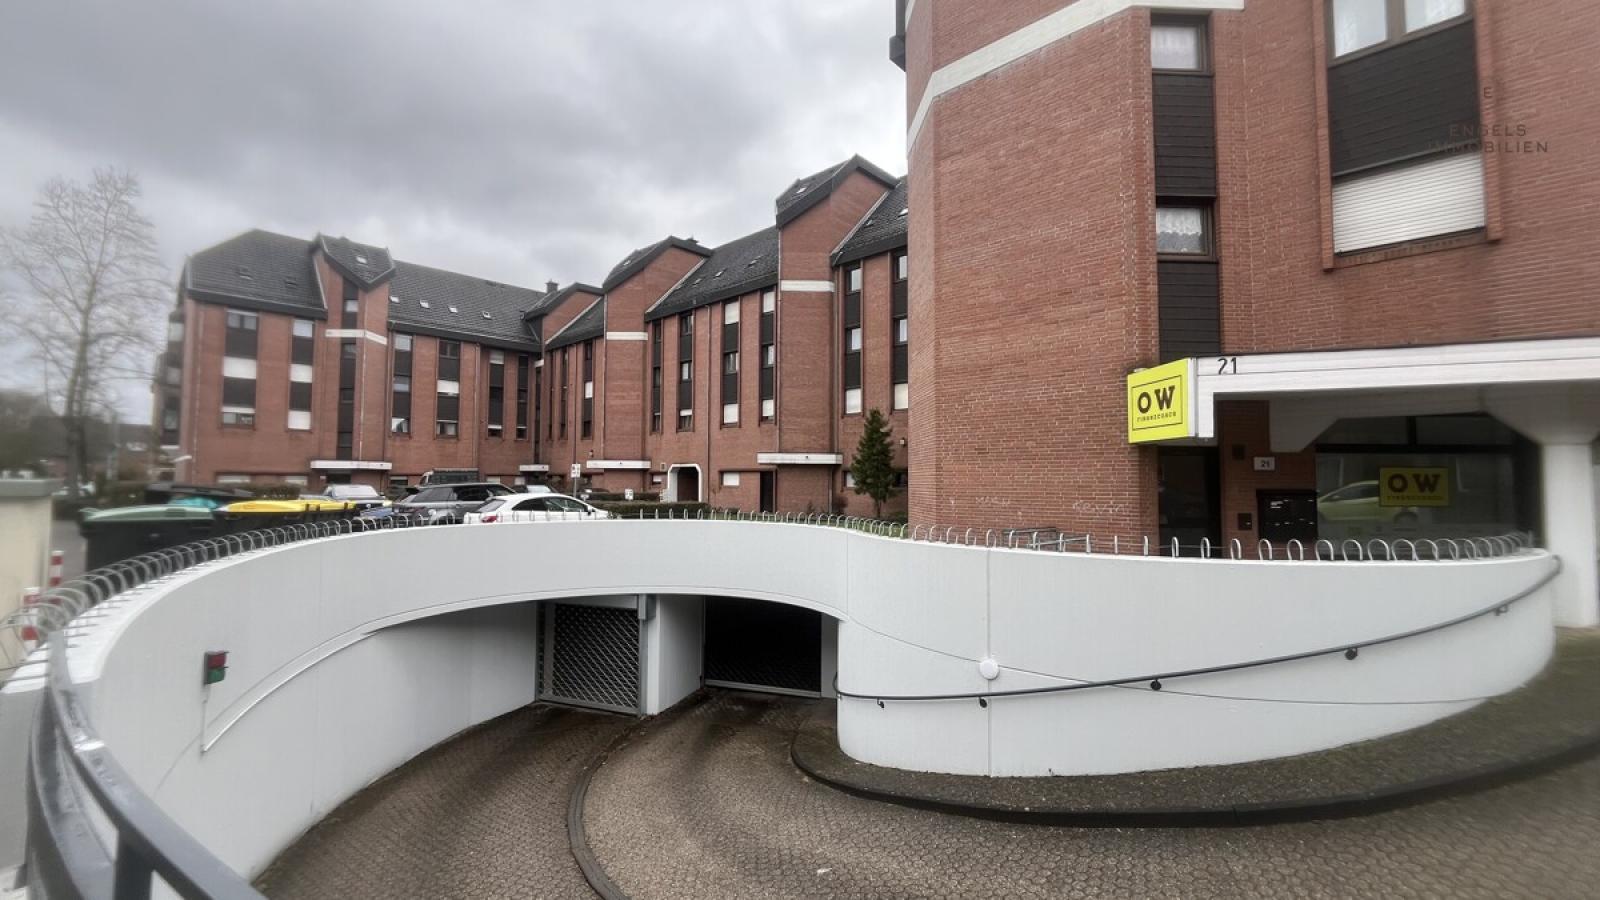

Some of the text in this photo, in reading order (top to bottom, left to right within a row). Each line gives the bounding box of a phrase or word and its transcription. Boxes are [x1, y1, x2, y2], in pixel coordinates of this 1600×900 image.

[1217, 357, 1237, 375] 21
[1137, 385, 1176, 414] OW
[1260, 459, 1271, 468] 21
[1387, 473, 1441, 493] OW
